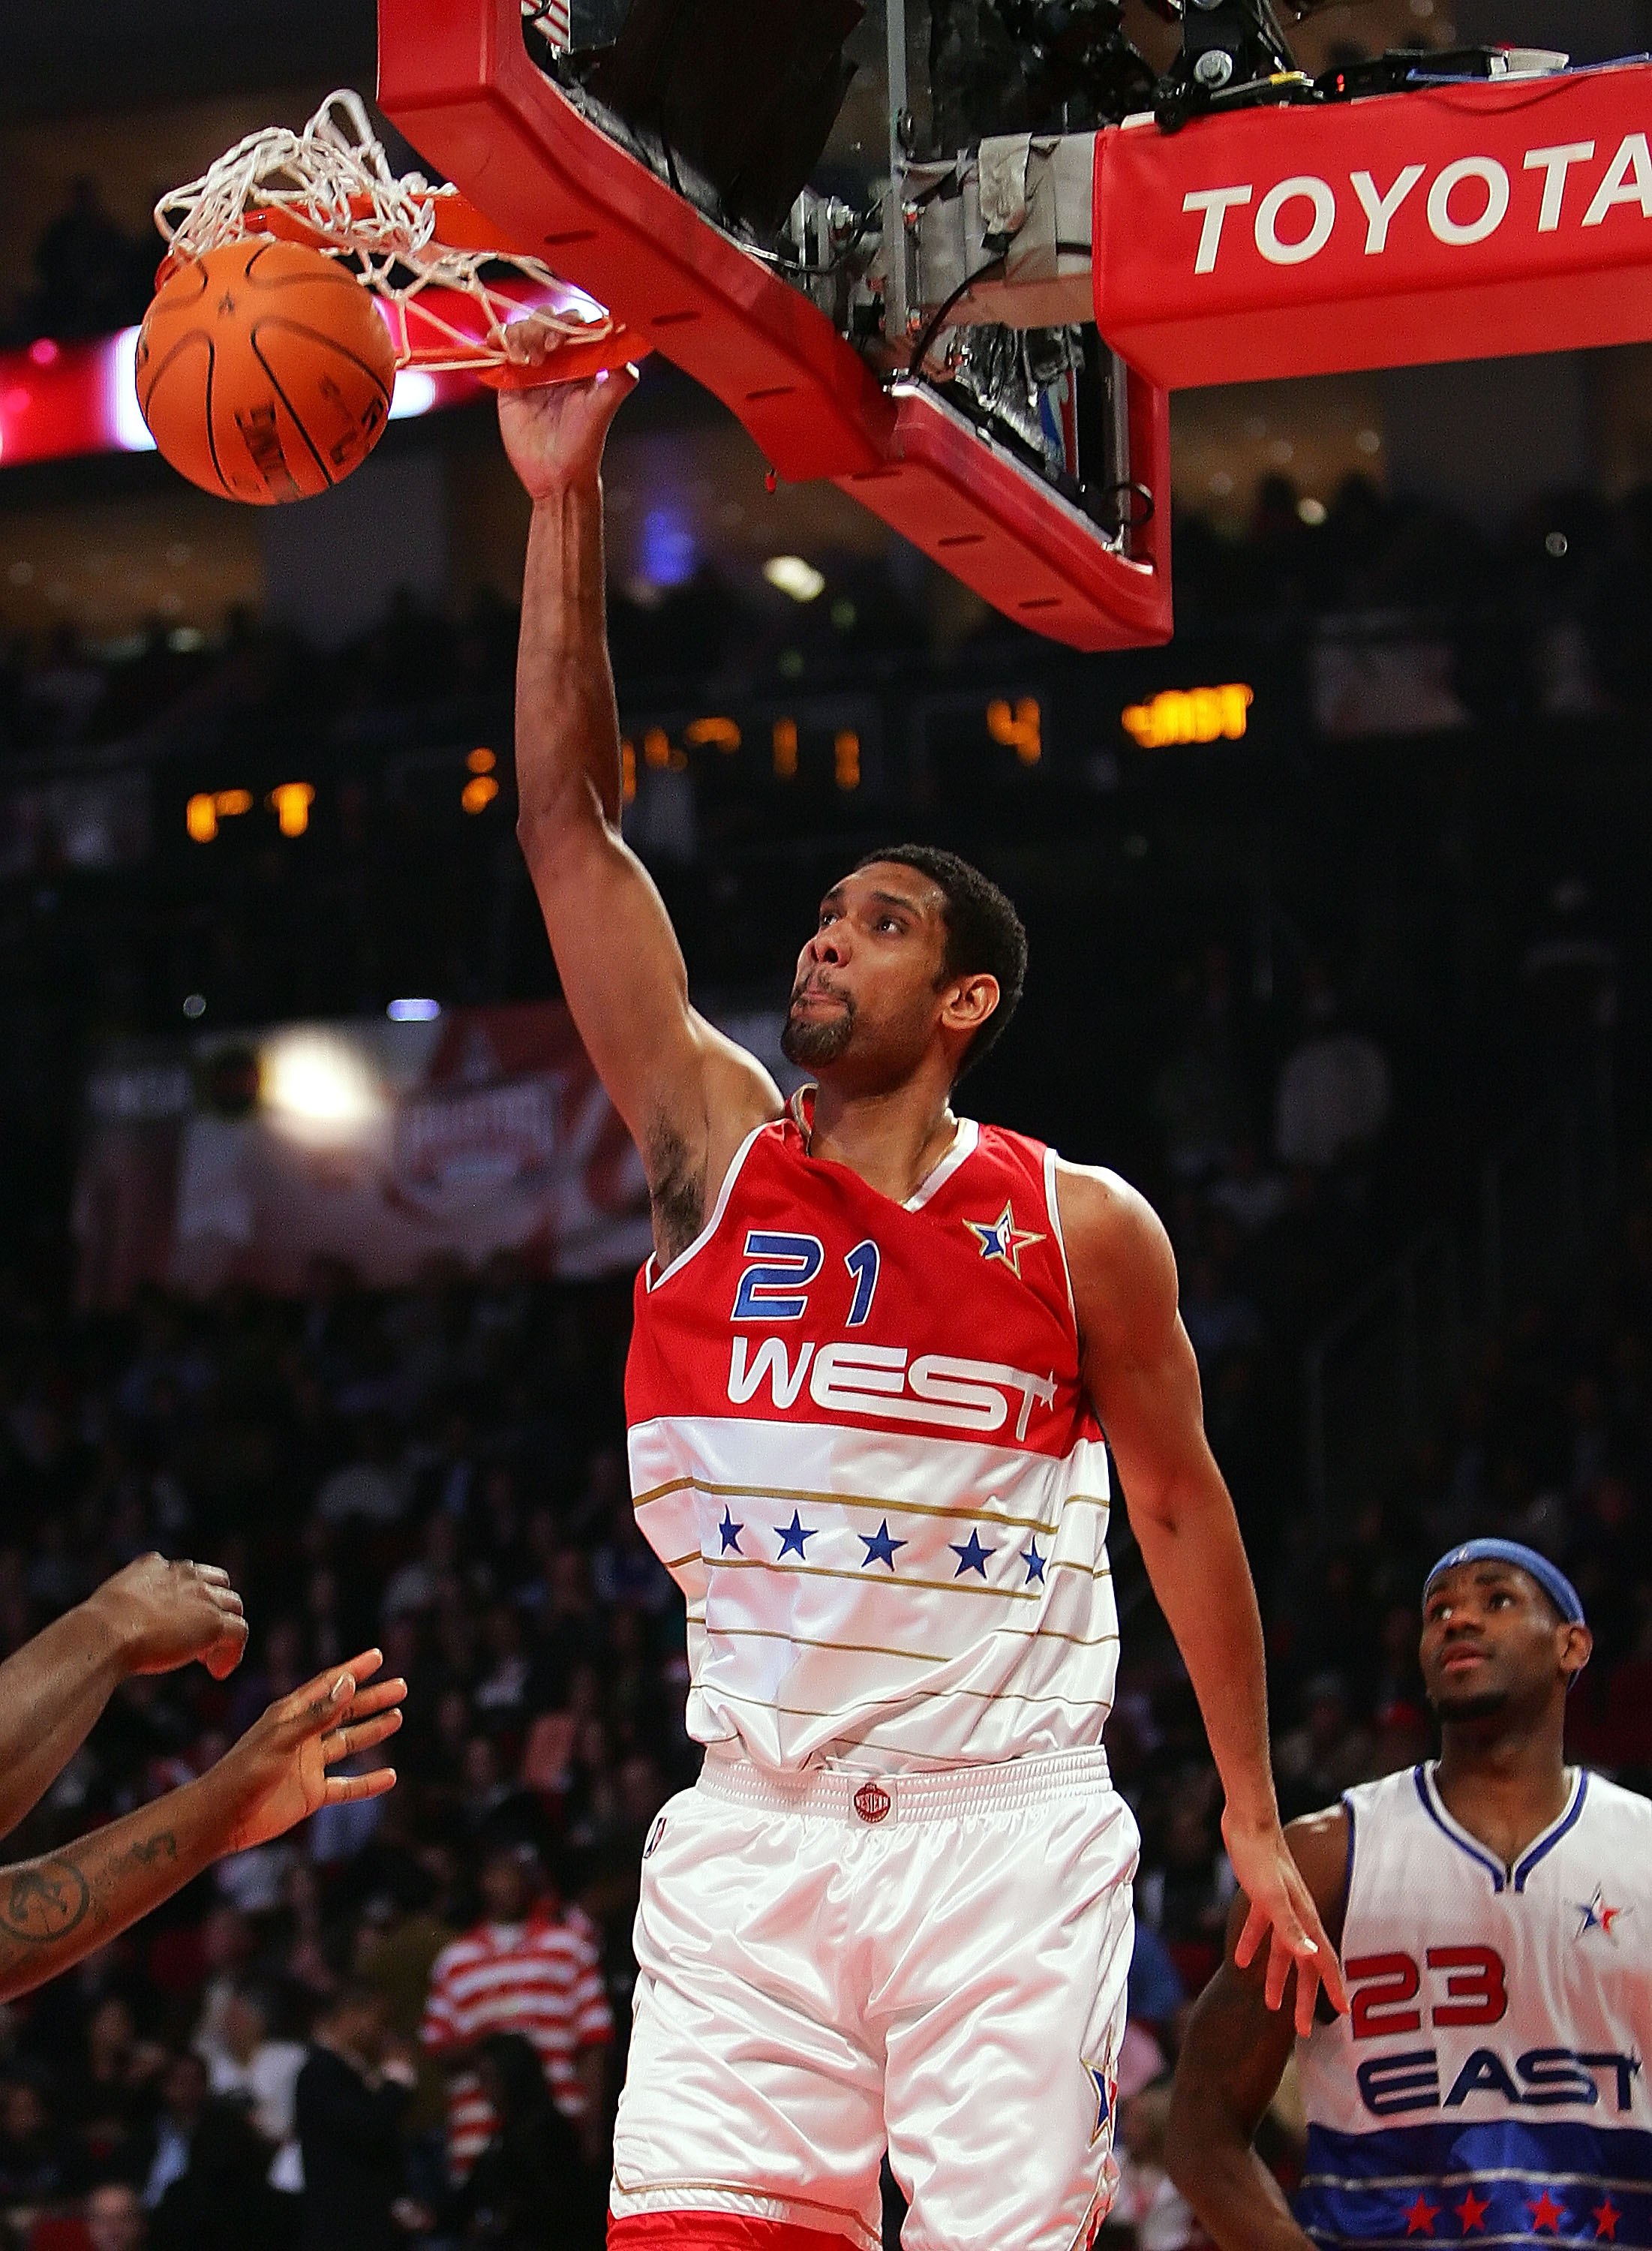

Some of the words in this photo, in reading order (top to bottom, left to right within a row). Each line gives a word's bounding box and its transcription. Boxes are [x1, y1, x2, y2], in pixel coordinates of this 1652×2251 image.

[1183, 132, 1652, 274] TOYOTA
[730, 1230, 880, 1327] 21
[726, 1336, 1059, 1442] WEST
[1345, 1945, 1508, 2039] 23
[1356, 2048, 1641, 2116] EAST
